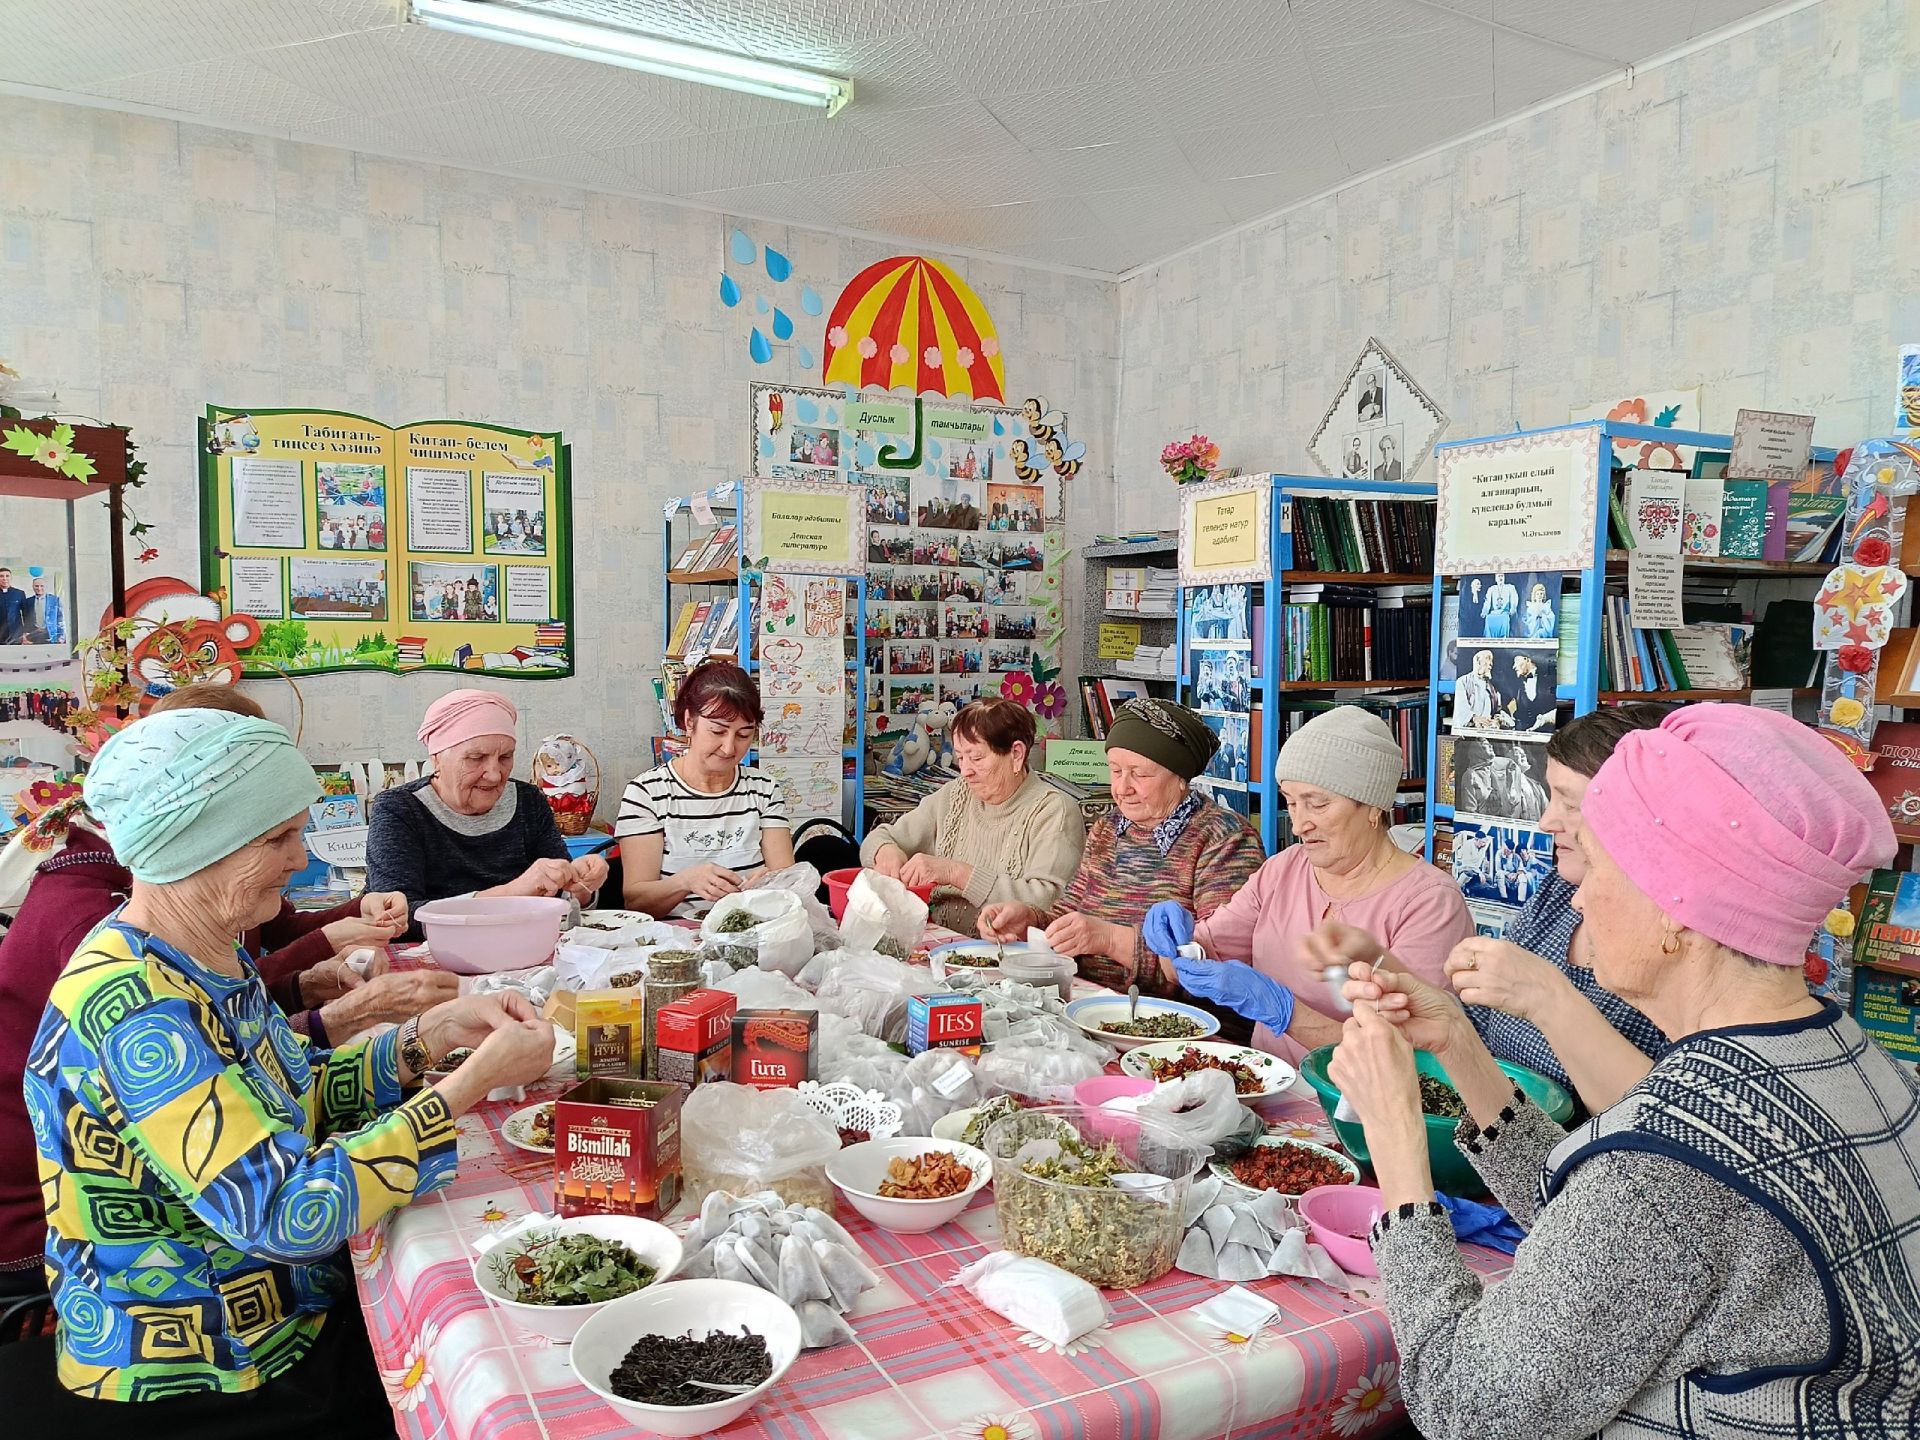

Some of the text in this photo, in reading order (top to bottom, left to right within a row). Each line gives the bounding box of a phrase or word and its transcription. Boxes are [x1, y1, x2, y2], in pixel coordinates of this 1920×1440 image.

[859, 411, 896, 425] Дуслык
[301, 424, 382, 441] Табигать-
[931, 419, 985, 432] тамчылары
[330, 442, 382, 455] хәзинә
[409, 432, 508, 452] Китап- белем
[409, 448, 476, 461] чишмәсе
[1503, 470, 1528, 482] укып
[1529, 465, 1555, 478] елый
[1216, 506, 1235, 516] Татар
[1515, 498, 1553, 512] булмый
[771, 511, 804, 523] Балалар
[1281, 505, 1290, 520] К
[789, 532, 823, 541] Детская
[780, 541, 828, 552] литература
[1865, 947, 1900, 961] НАРОДА
[1863, 1001, 1888, 1011] ОРДЕНА
[706, 1008, 731, 1039] TESS
[936, 1011, 974, 1034] TESS
[939, 1038, 970, 1047] SUNRISE
[593, 1045, 625, 1057] НУРИ
[751, 1059, 787, 1077] Гита
[567, 1132, 631, 1157] Bismillah
